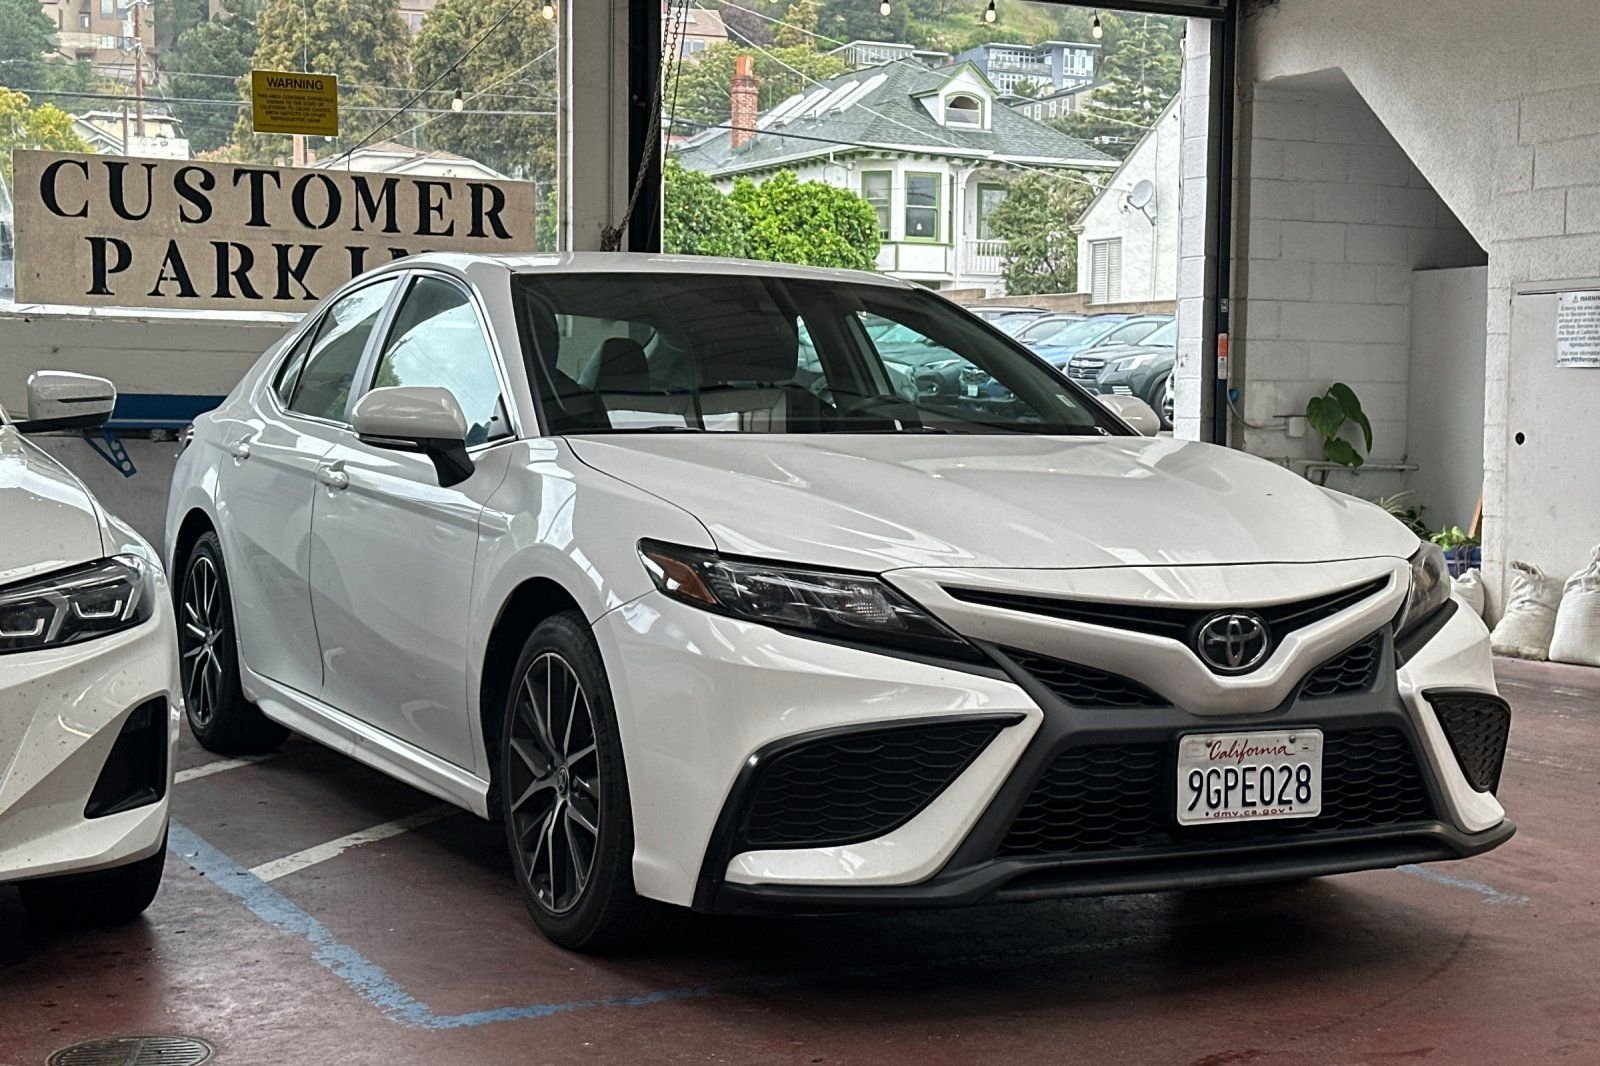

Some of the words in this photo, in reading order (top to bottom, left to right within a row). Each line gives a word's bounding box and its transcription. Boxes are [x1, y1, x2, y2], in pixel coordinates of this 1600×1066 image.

[266, 76, 324, 90] WARNING
[40, 159, 513, 240] CUSTOMER
[85, 236, 436, 300] PARKI
[1209, 739, 1295, 765] California
[1187, 764, 1312, 811] 9GPE028
[1213, 807, 1286, 818] dmv.ca.gov
